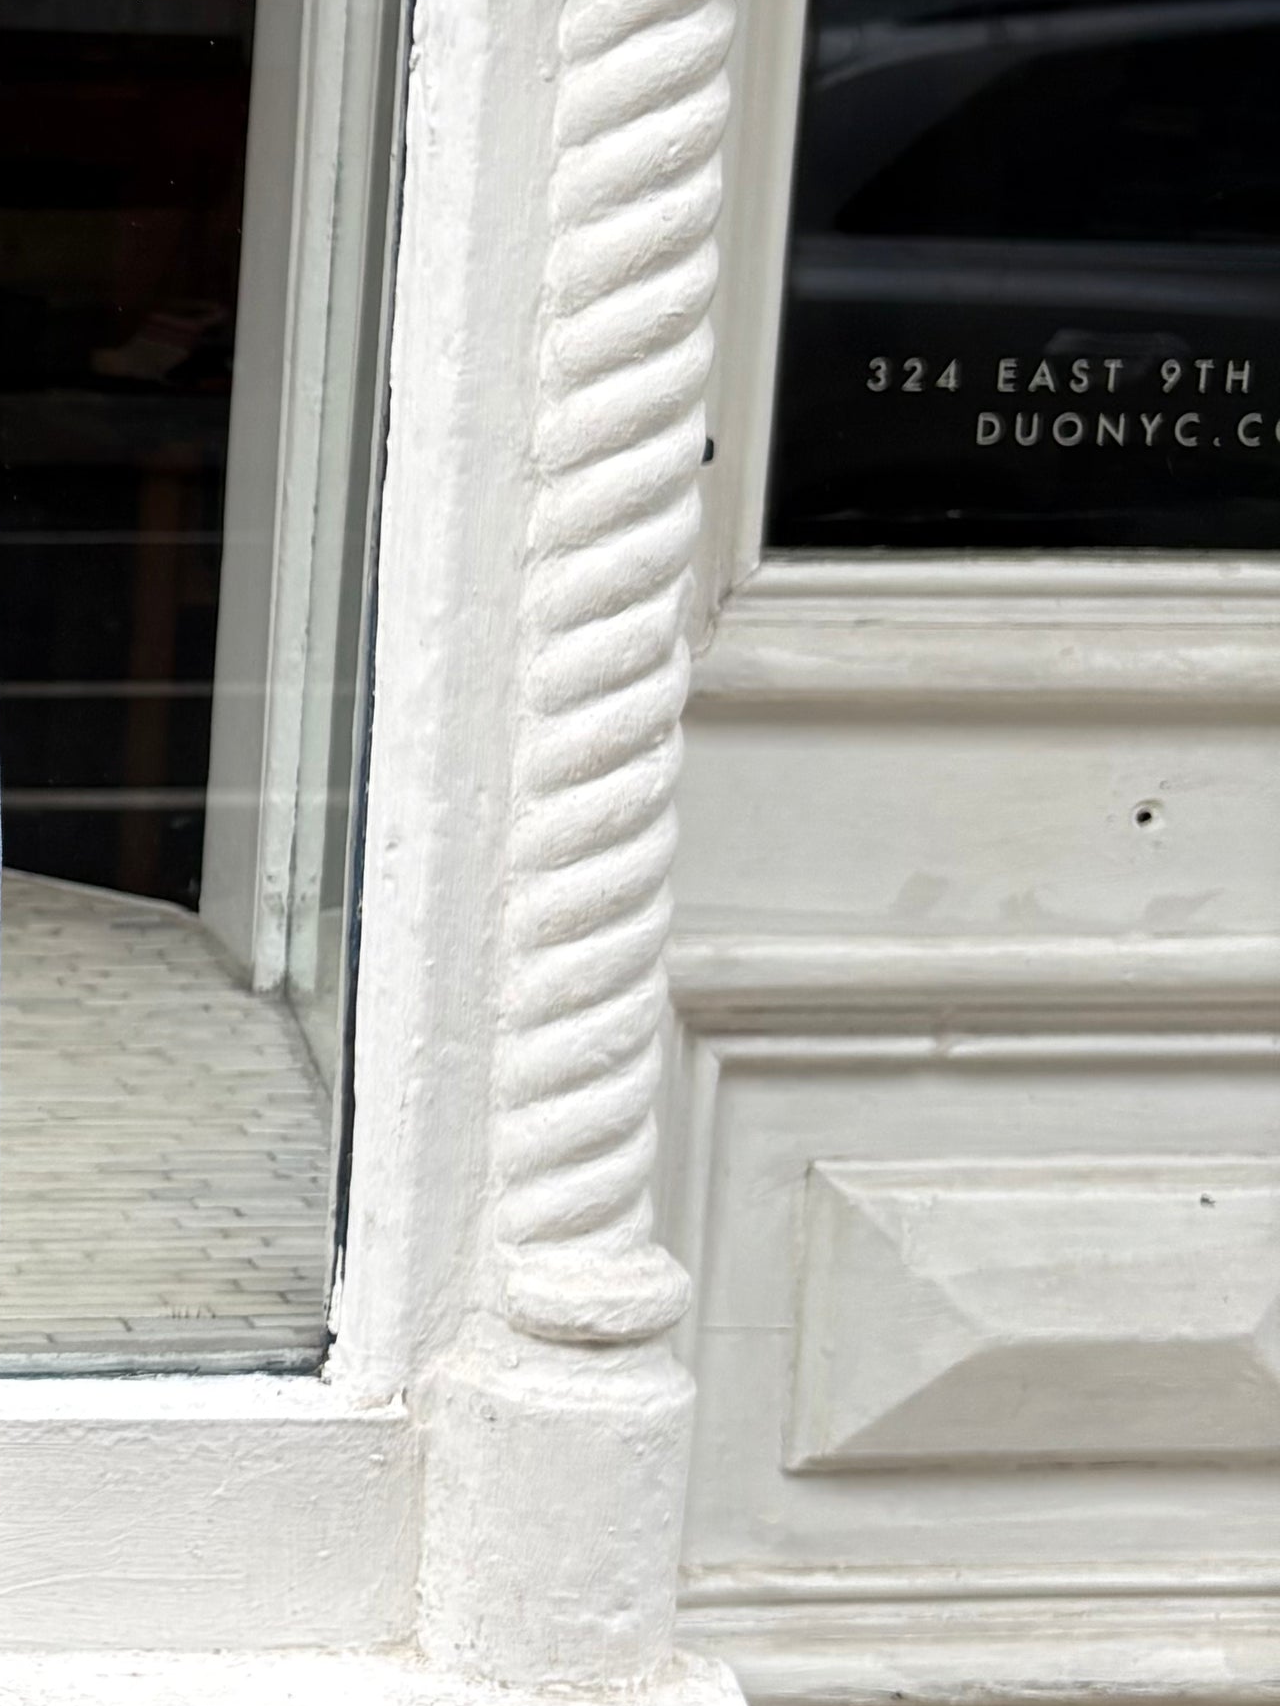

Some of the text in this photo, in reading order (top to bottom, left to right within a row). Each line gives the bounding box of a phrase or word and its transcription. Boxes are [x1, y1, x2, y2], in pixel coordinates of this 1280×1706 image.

[867, 357, 1251, 394] 324 EAST 9TH
[976, 411, 1280, 447] DUONYC.C
